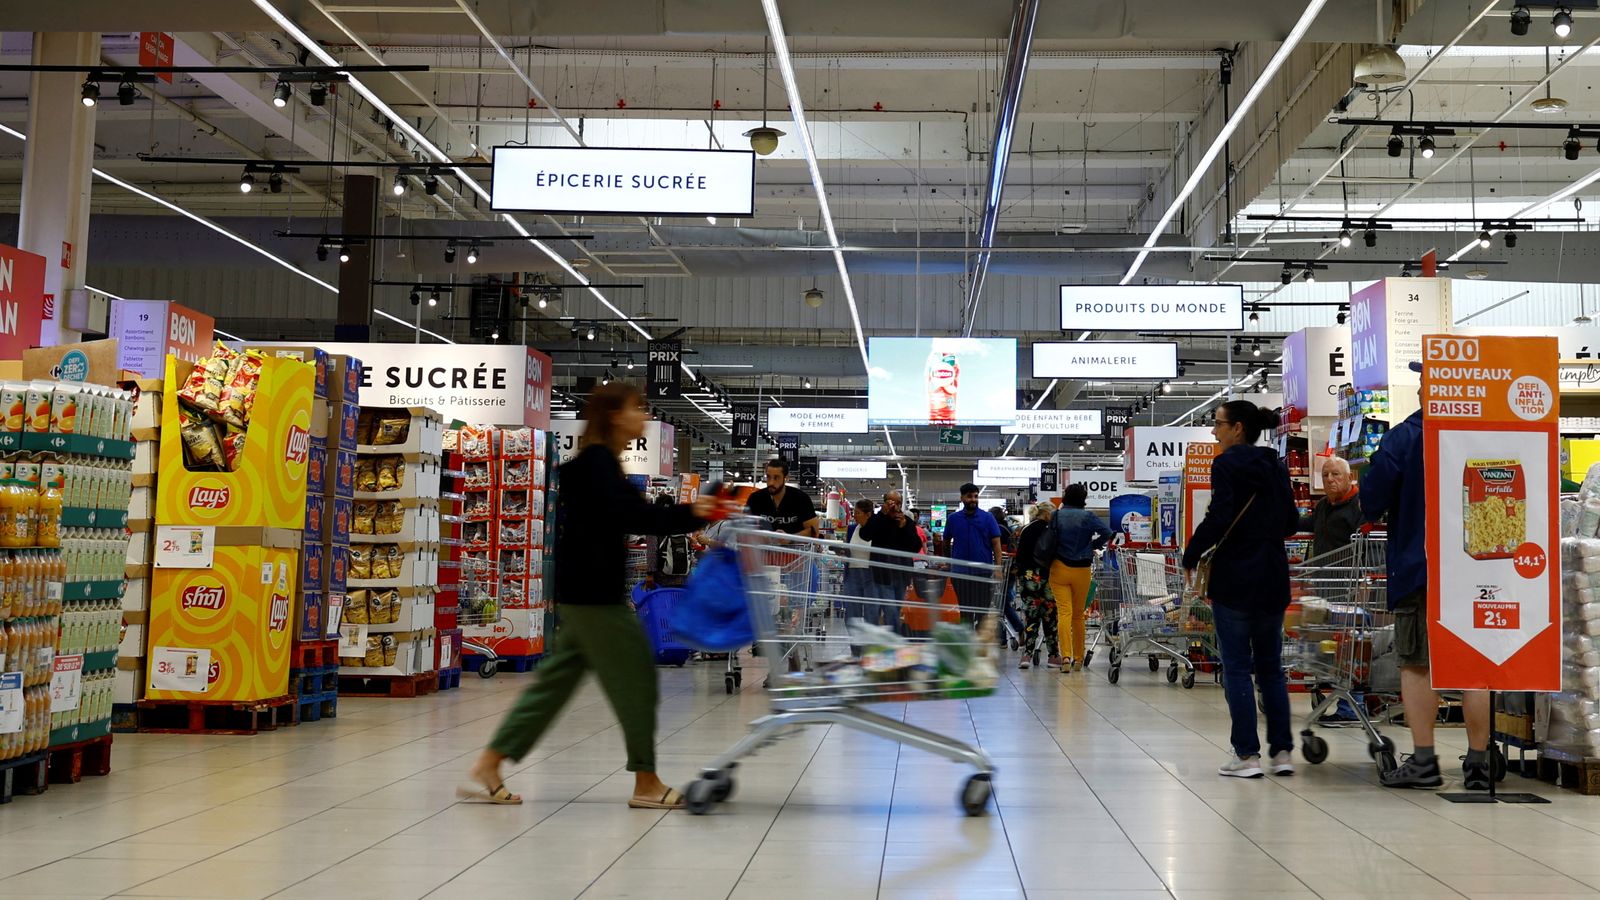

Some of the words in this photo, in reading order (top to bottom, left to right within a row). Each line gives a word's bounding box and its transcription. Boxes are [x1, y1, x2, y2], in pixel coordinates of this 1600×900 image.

[536, 170, 623, 188] ÉPICERIE
[631, 173, 707, 190] SUCRÉE
[1408, 293, 1419, 302] 34
[1075, 303, 1146, 313] PRODUITS
[1151, 303, 1170, 313] DU
[1175, 303, 1227, 313] MONDE
[139, 313, 149, 321] 19
[1352, 298, 1371, 335] BON
[170, 312, 196, 347] BON
[649, 343, 679, 351] BORNE
[1353, 333, 1377, 372] PLAN
[1429, 340, 1477, 360] 500
[649, 351, 679, 361] PRIX
[1071, 356, 1137, 365] ANIMALERIE
[386, 363, 506, 389] SUCRÉE
[1429, 367, 1512, 380] NOUVEAUX
[1429, 385, 1463, 397] PRIX
[1467, 386, 1486, 397] EN
[389, 396, 434, 405] Biscuits
[438, 396, 446, 405] &
[450, 395, 506, 407] Pâtisserie
[527, 385, 545, 411] PLAN
[1515, 398, 1545, 406] INFLA
[1429, 403, 1480, 414] BAISSE
[1521, 406, 1545, 414] TION
[288, 425, 310, 464] Lay's
[1189, 445, 1213, 454] 500
[1483, 471, 1512, 479] PANZANI
[1485, 486, 1512, 494] Farfalle
[190, 486, 229, 509] Lay's
[183, 586, 224, 609] Lay's
[270, 594, 289, 632] Lay's
